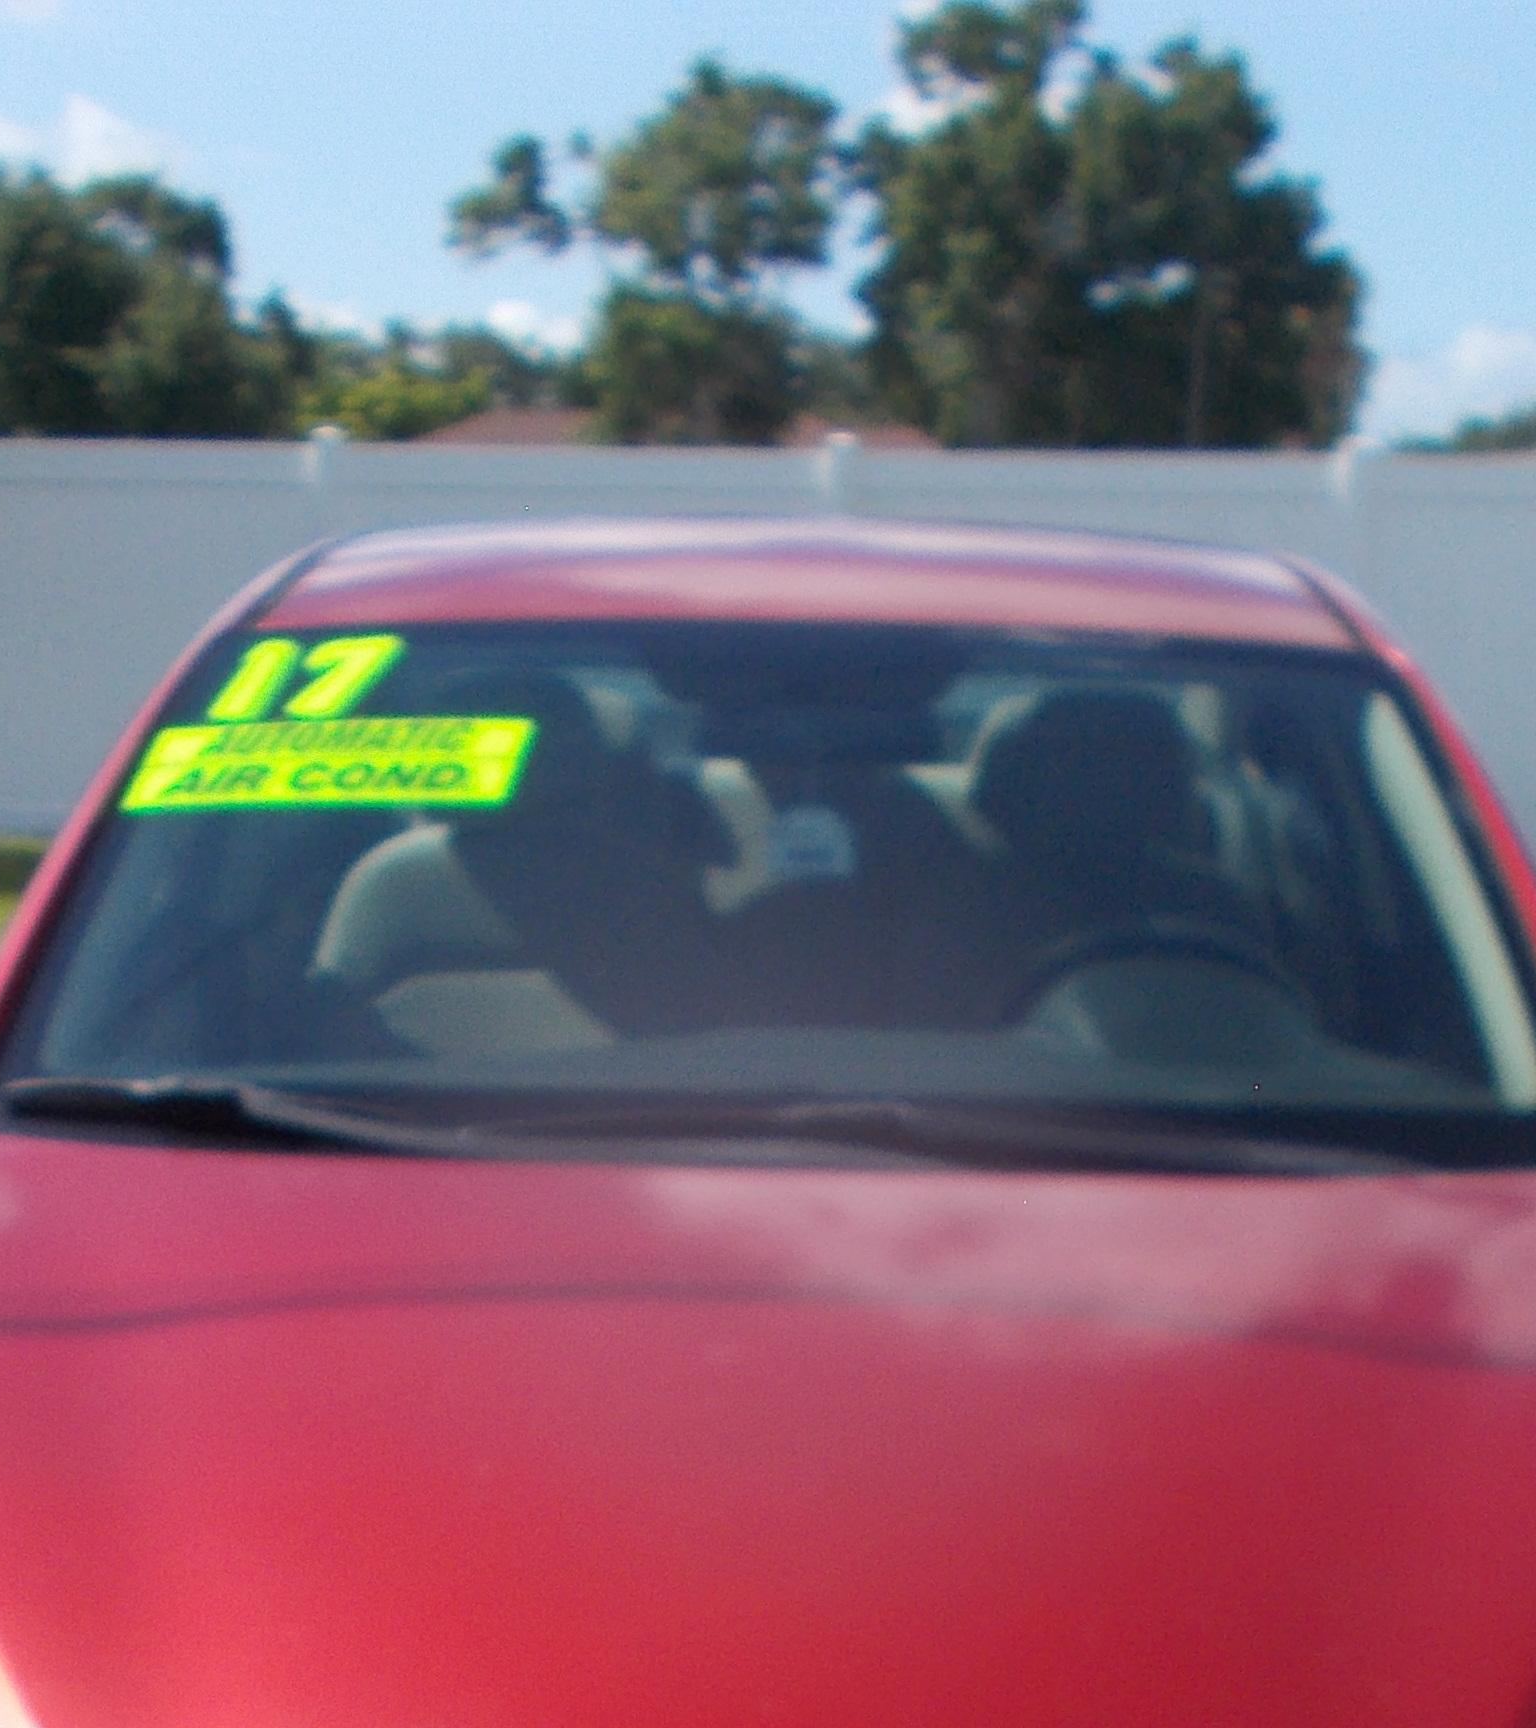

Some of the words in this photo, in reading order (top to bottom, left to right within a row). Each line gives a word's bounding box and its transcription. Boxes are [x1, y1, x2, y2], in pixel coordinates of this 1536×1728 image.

[205, 634, 407, 719] 17
[163, 763, 273, 793] AIR
[288, 761, 467, 791] COND
